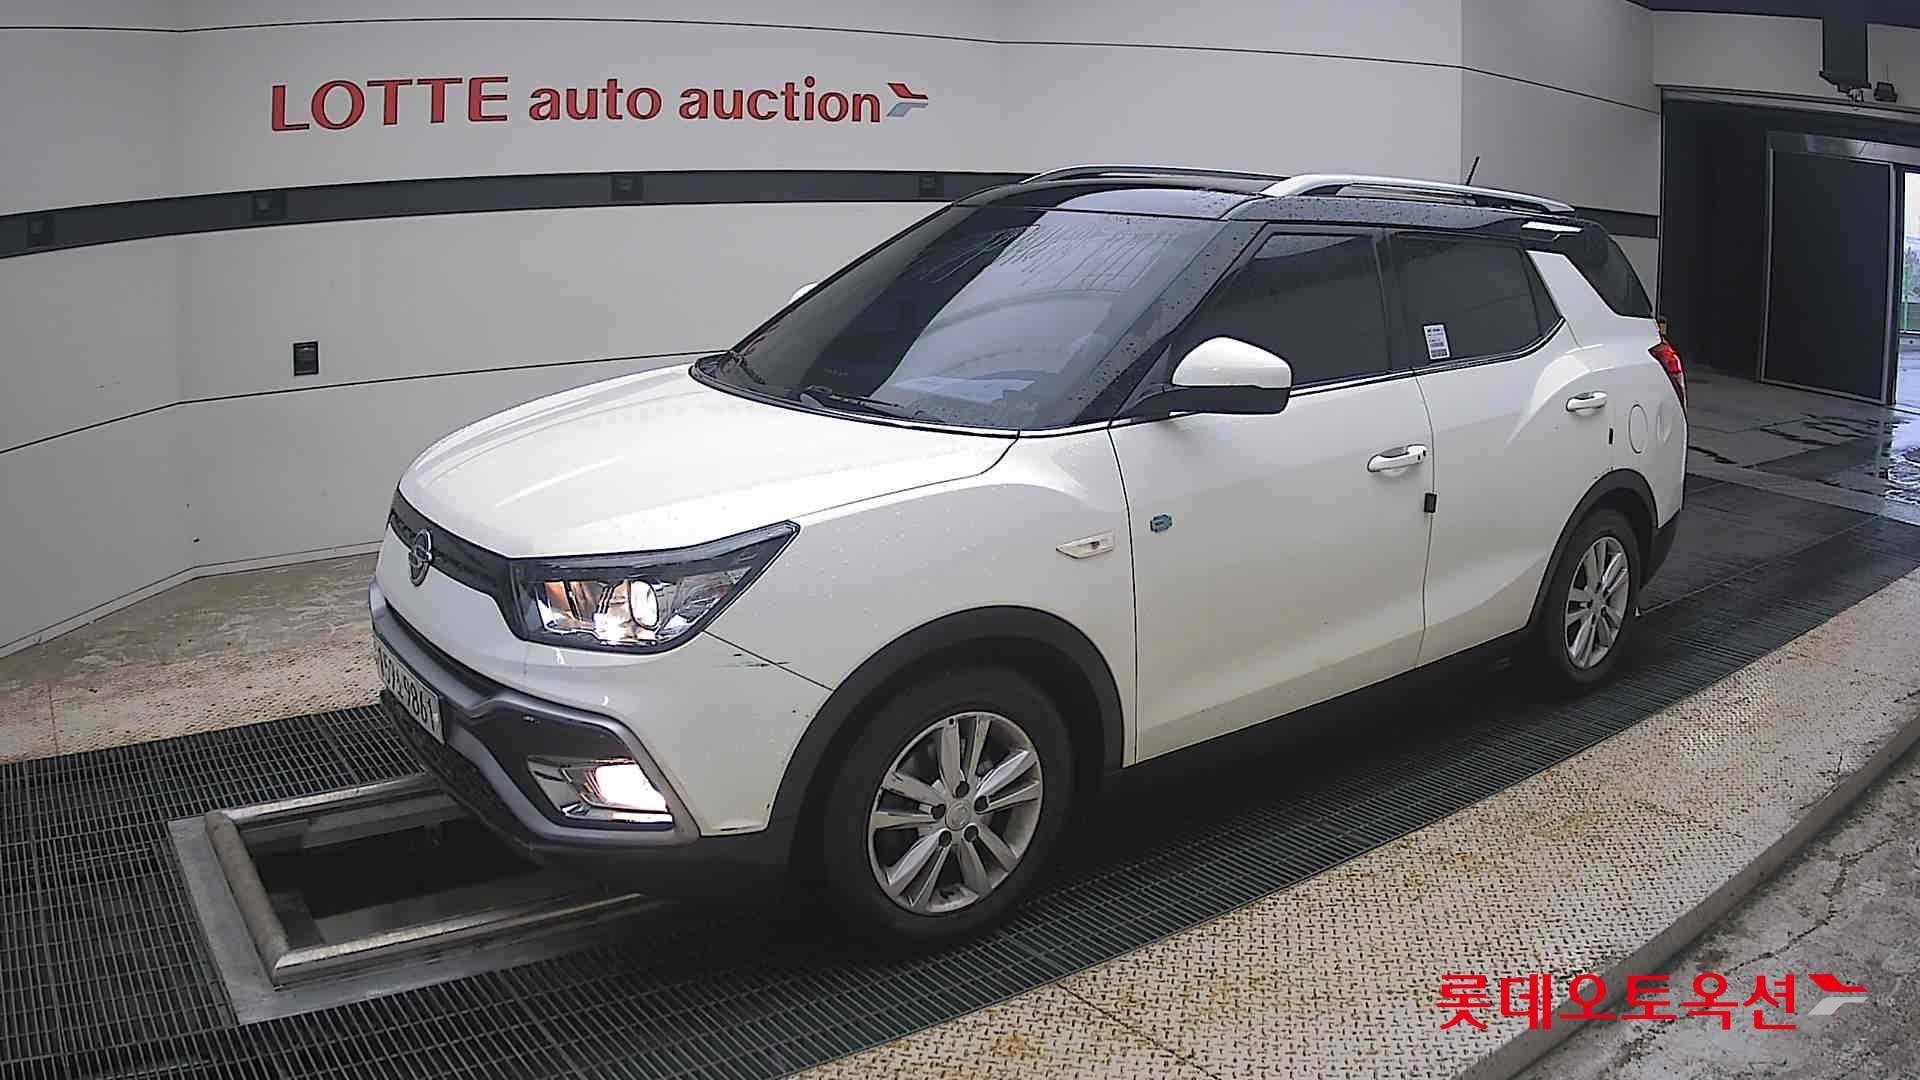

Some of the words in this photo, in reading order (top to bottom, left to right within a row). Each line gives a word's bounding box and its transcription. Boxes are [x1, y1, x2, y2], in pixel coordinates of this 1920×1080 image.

[271, 75, 509, 132] LOTTE
[528, 78, 662, 121] auto
[678, 76, 882, 123] auction
